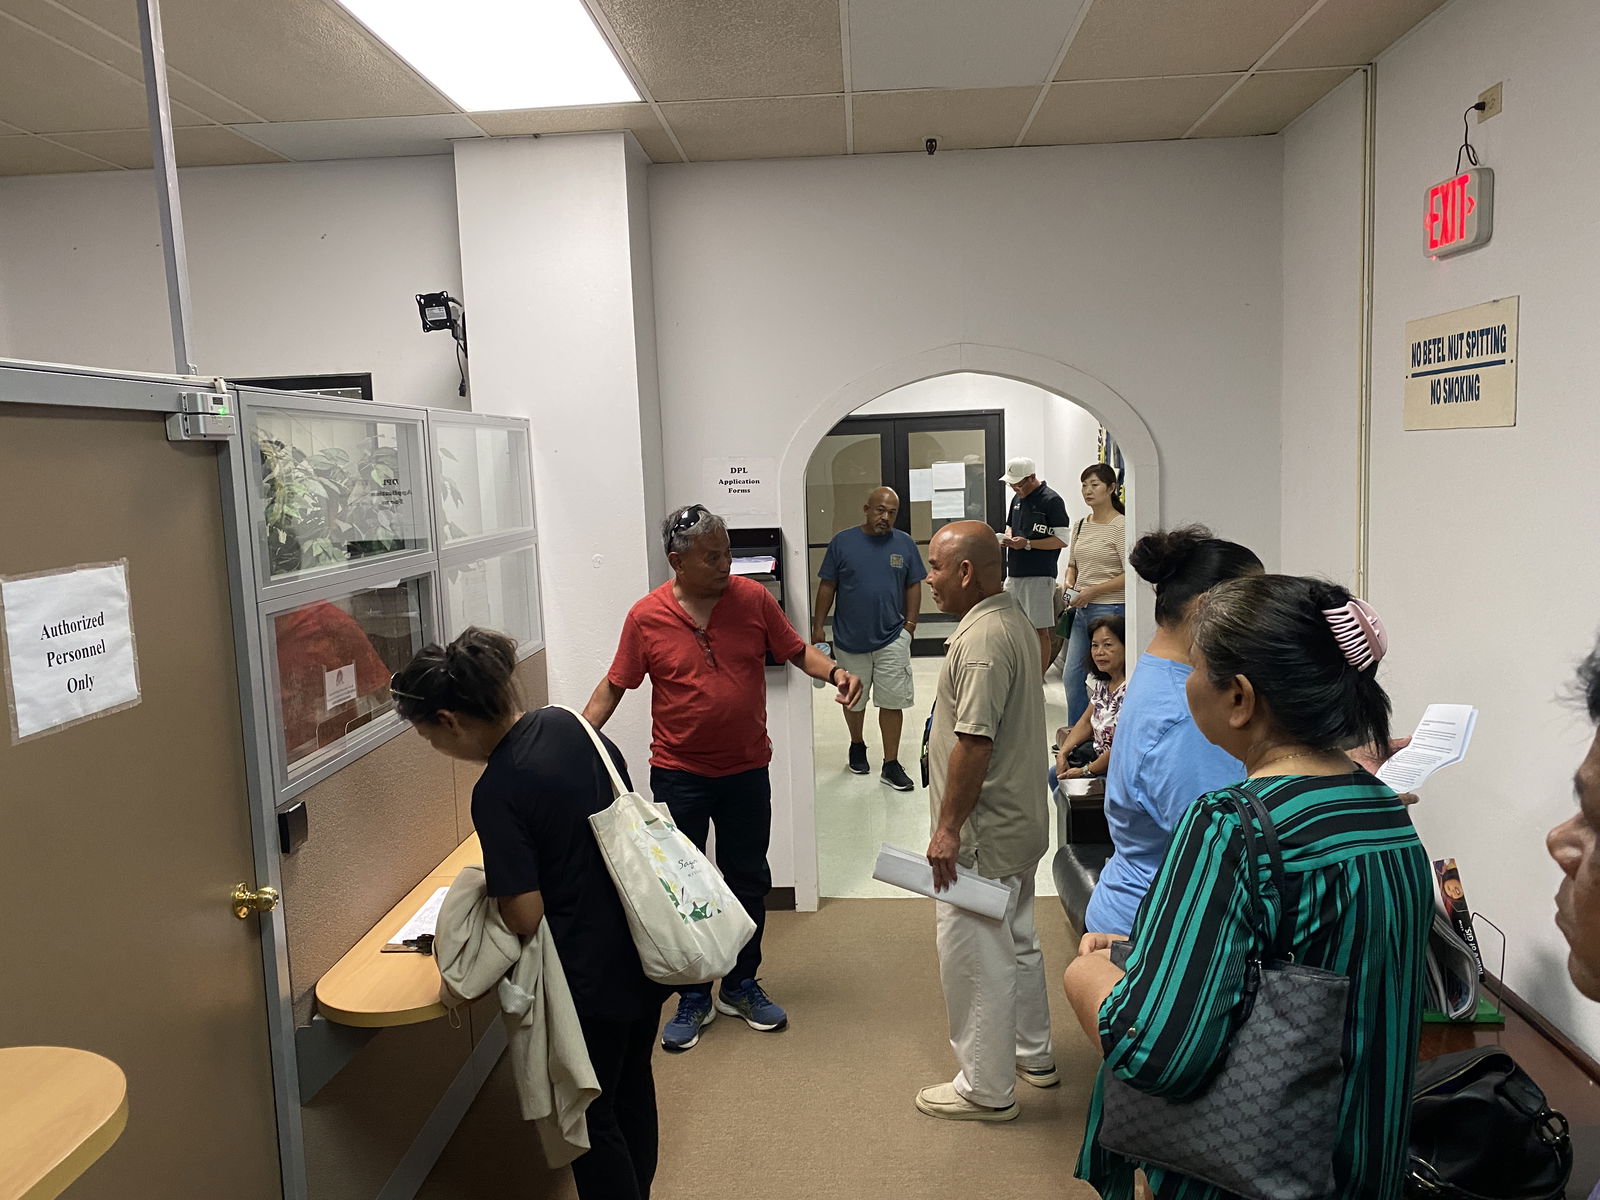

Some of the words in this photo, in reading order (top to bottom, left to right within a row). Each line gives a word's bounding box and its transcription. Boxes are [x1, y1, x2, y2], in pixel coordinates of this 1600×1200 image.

[1429, 174, 1470, 250] EXIT
[1411, 341, 1421, 368] NO
[1423, 337, 1445, 365] BETEL
[1448, 332, 1464, 361] NUT
[1466, 324, 1507, 359] SPITTING
[1431, 378, 1441, 405] NO
[1443, 373, 1480, 404] SMOKING
[40, 611, 104, 640] Authorized
[46, 639, 106, 668] Personnel
[67, 673, 95, 694] Only
